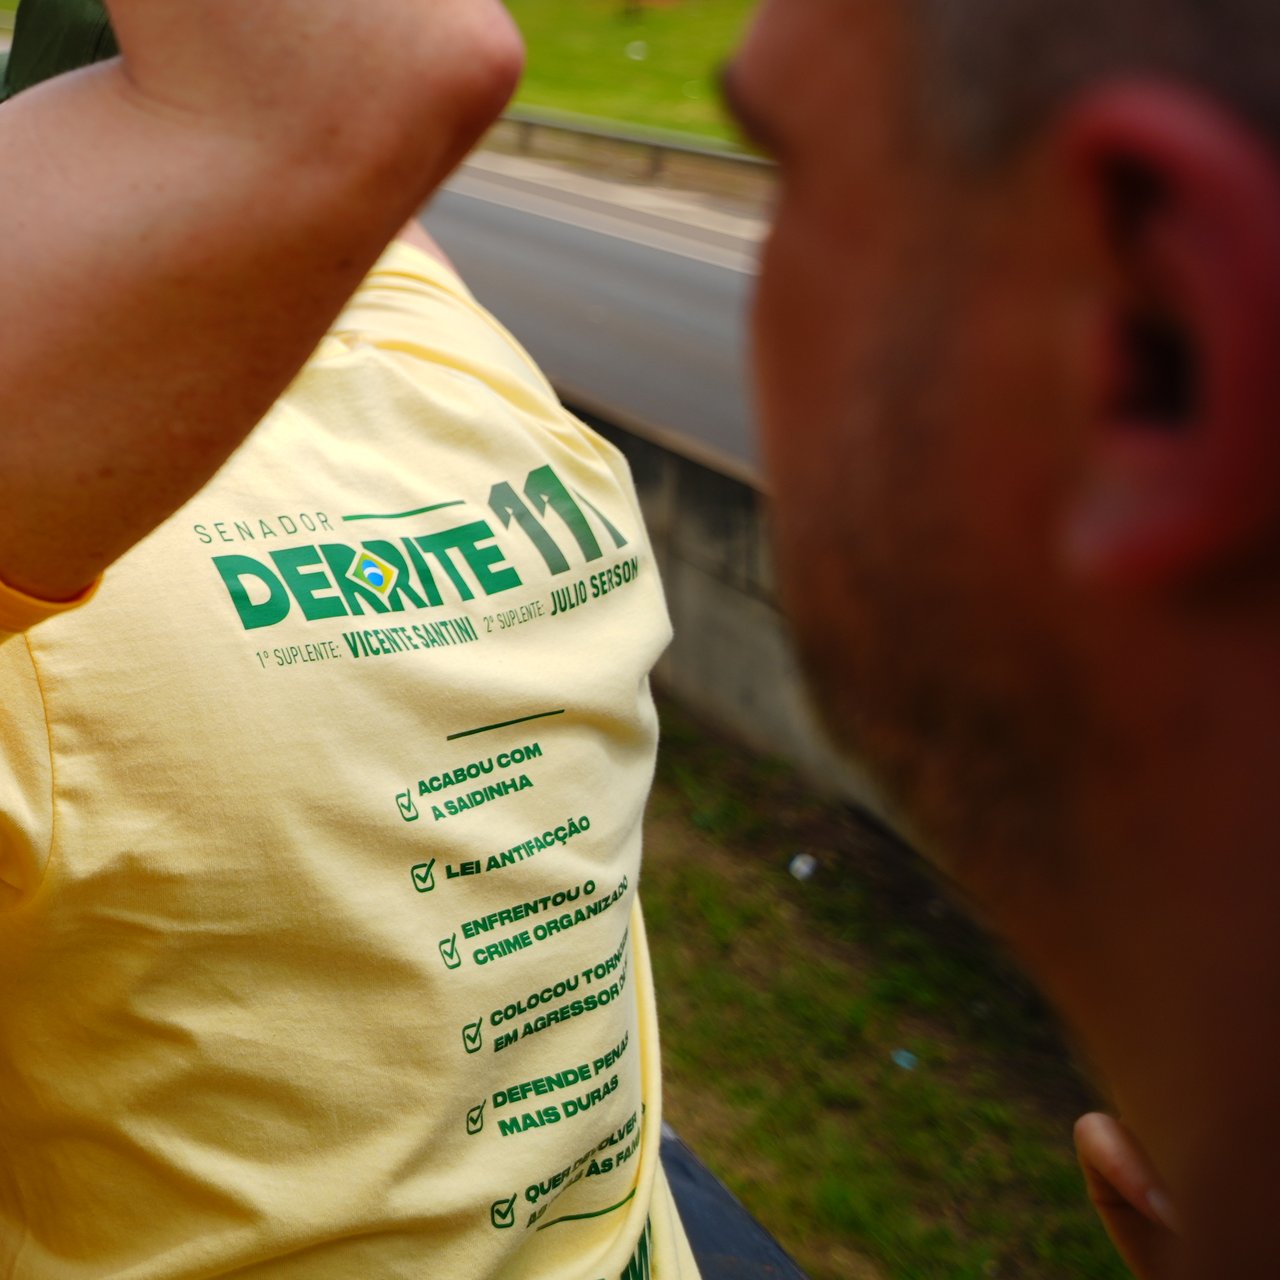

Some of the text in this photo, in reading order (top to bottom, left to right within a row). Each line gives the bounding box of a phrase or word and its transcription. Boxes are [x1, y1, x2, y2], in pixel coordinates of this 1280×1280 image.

[193, 511, 335, 545] SENADOR
[211, 519, 523, 631] DERRITE
[273, 640, 342, 666] SUPLENTE:
[342, 624, 418, 658] VICENTE
[413, 616, 479, 650] SANTINI
[496, 600, 546, 632] SUPLENTE:
[551, 579, 588, 616] JULIO
[590, 555, 639, 599] SERSON
[417, 742, 543, 797] ACABOU COM
[431, 774, 534, 821] A SAIDINHA
[445, 815, 591, 880] LEI ANTIFACÇÃO
[461, 880, 596, 939] ENFRENTOU O
[472, 874, 629, 966] CRIME ORGANIZADO
[490, 974, 579, 1026] COLOCOU
[493, 982, 619, 1053] EM AGRESSOR
[492, 1063, 592, 1109] DEFENDE
[497, 1074, 619, 1137] MAIS DURAS
[525, 1166, 571, 1205] QUER
